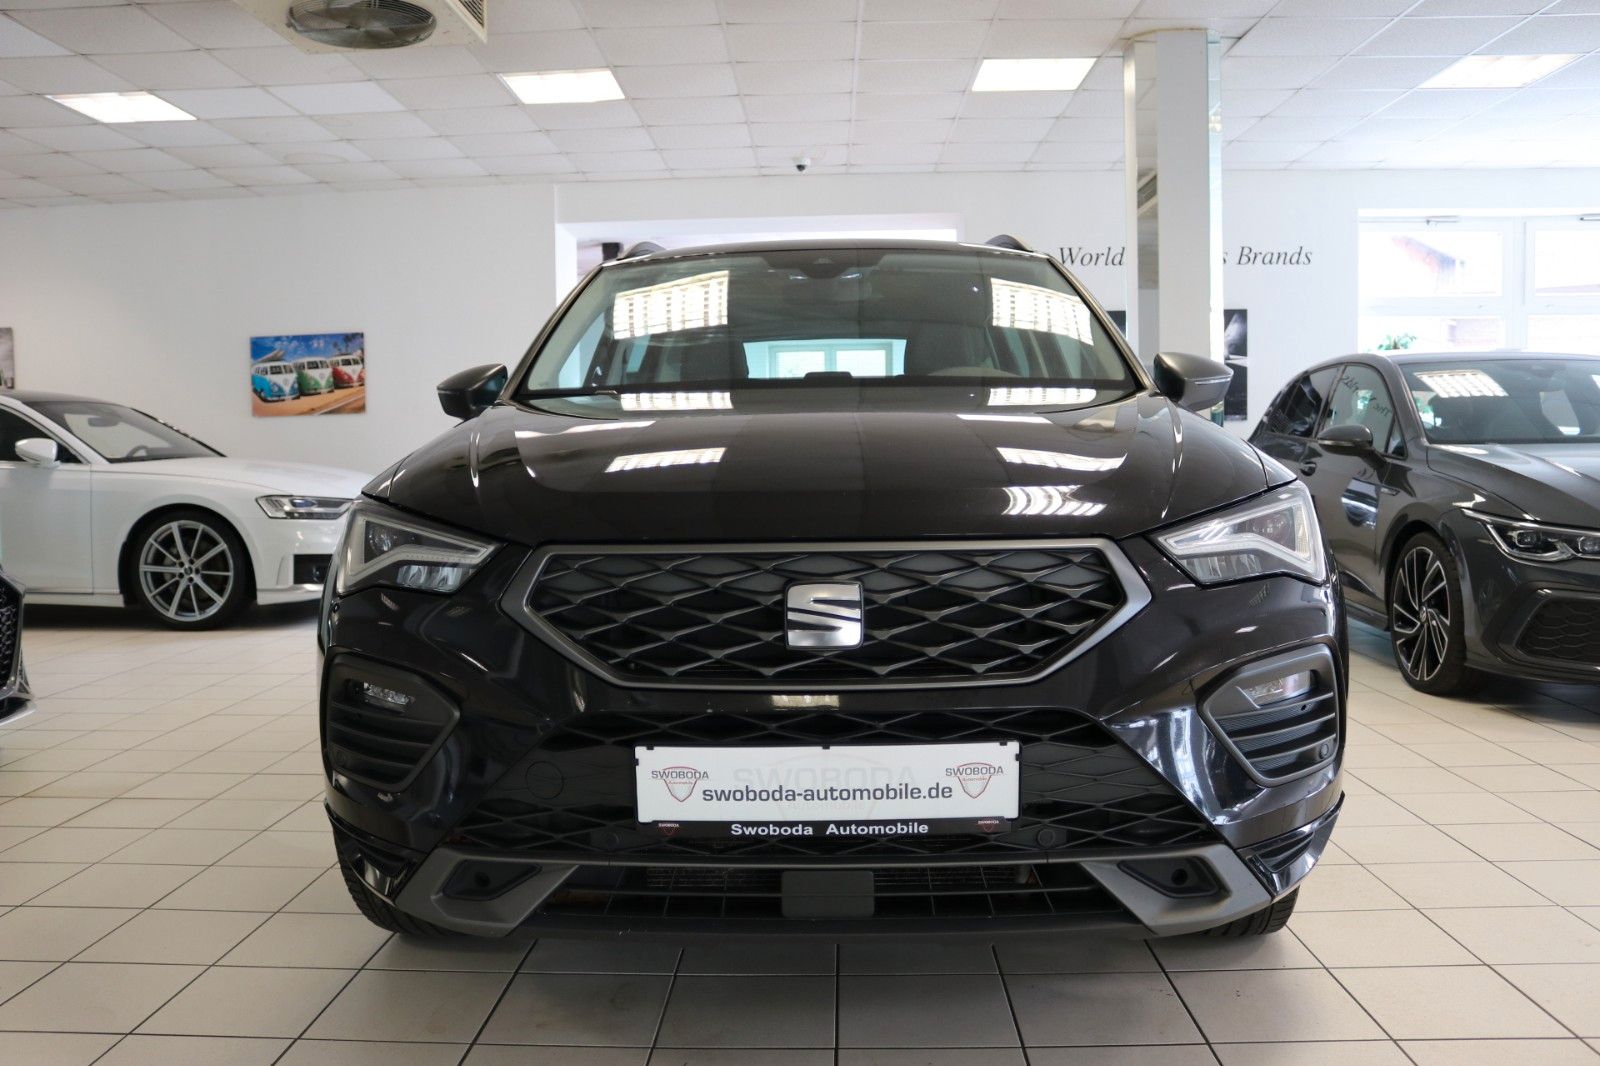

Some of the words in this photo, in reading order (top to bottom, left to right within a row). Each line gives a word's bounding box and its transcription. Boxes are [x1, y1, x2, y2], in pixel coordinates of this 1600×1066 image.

[1236, 245, 1313, 265] Brands
[651, 770, 709, 780] SWOBODA
[945, 766, 1004, 776] SWOBODA
[703, 782, 953, 802] swoboda-automobile.de
[731, 823, 814, 836] Swoboda
[825, 822, 929, 835] Automobile
